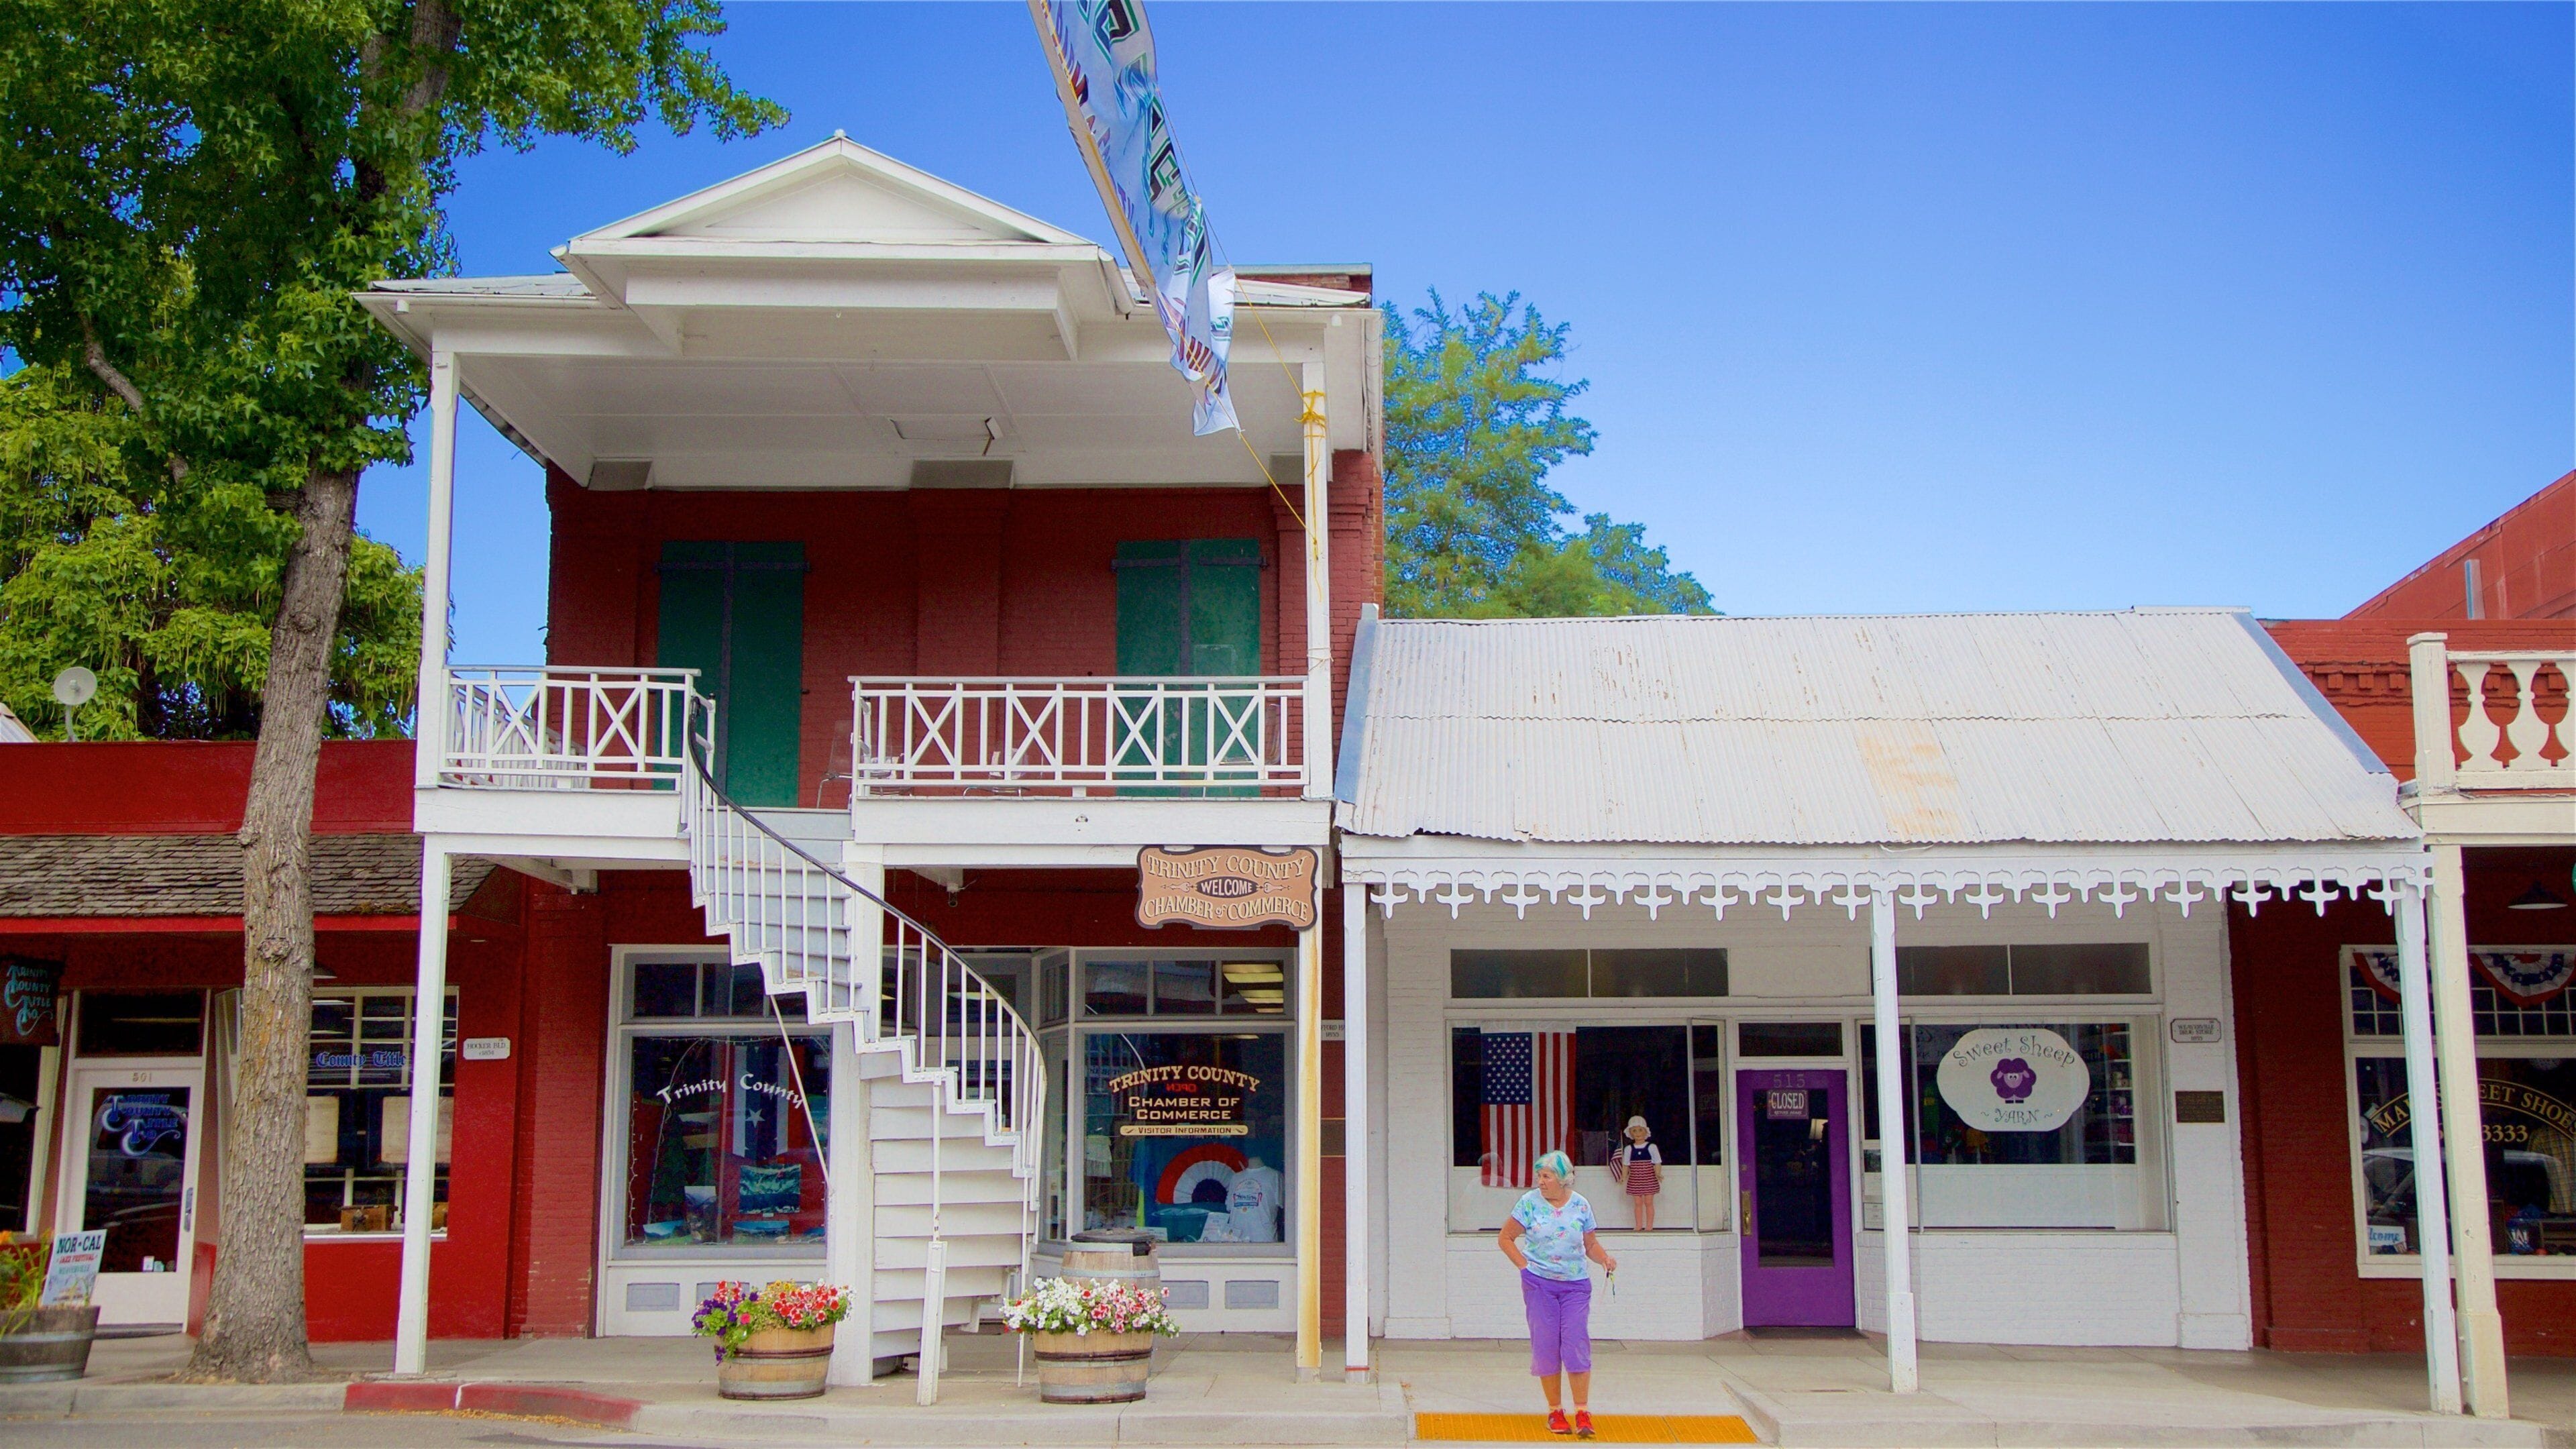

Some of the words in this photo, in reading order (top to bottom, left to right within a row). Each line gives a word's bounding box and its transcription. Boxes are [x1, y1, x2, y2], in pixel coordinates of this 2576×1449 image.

[1146, 855, 1221, 879] TRINITY
[1226, 855, 1307, 881] COUNTY
[1200, 878, 1252, 896] WELCOME
[1144, 896, 1214, 919] CHAMBER
[1215, 904, 1226, 918] of
[1226, 896, 1308, 922] COMMERCE
[316, 1051, 366, 1069] County
[372, 1051, 407, 1067] Title
[1953, 1037, 2012, 1067] Sweet
[2019, 1035, 2075, 1068] Sheep
[133, 1073, 152, 1082] 501
[1109, 1066, 1183, 1093] TRINITY
[1187, 1066, 1260, 1092] COUNTY
[1773, 1074, 1806, 1088] 515
[657, 1079, 727, 1104] Trinity
[739, 1073, 804, 1109] County
[1128, 1096, 1210, 1107] CHAMBER
[1218, 1097, 1240, 1107] OF
[1771, 1092, 1805, 1109] CLOSED
[1136, 1109, 1231, 1120] COMMERCE
[1994, 1108, 2039, 1125] YARN
[2374, 1099, 2410, 1133] MA
[2369, 1228, 2400, 1241] lcome
